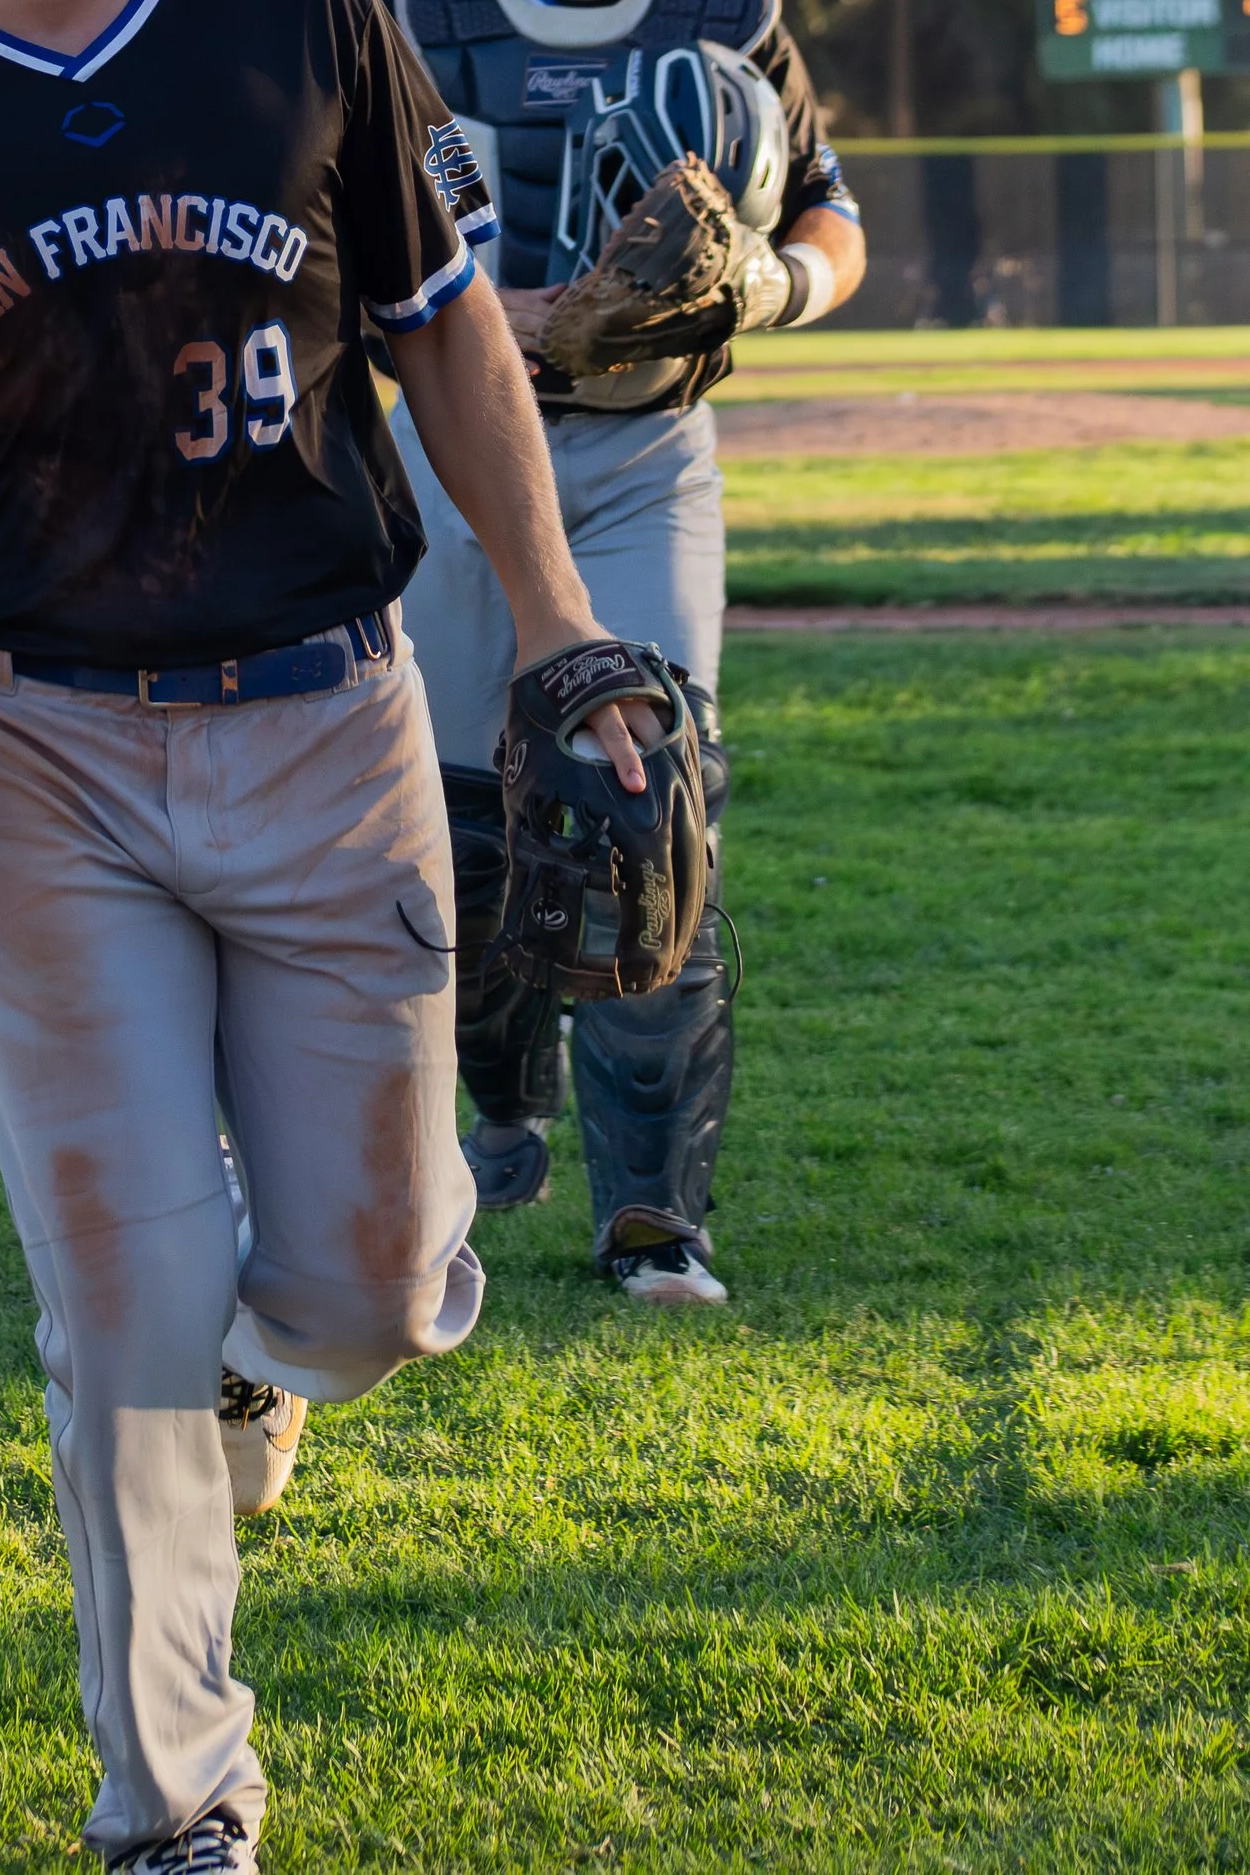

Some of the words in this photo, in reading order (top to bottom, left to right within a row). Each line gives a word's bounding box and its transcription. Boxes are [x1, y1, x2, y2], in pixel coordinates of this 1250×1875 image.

[27, 192, 310, 284] FRANCISCO
[171, 321, 298, 463] 39
[557, 654, 625, 698] Rawlings
[638, 857, 666, 950] Rawlings
